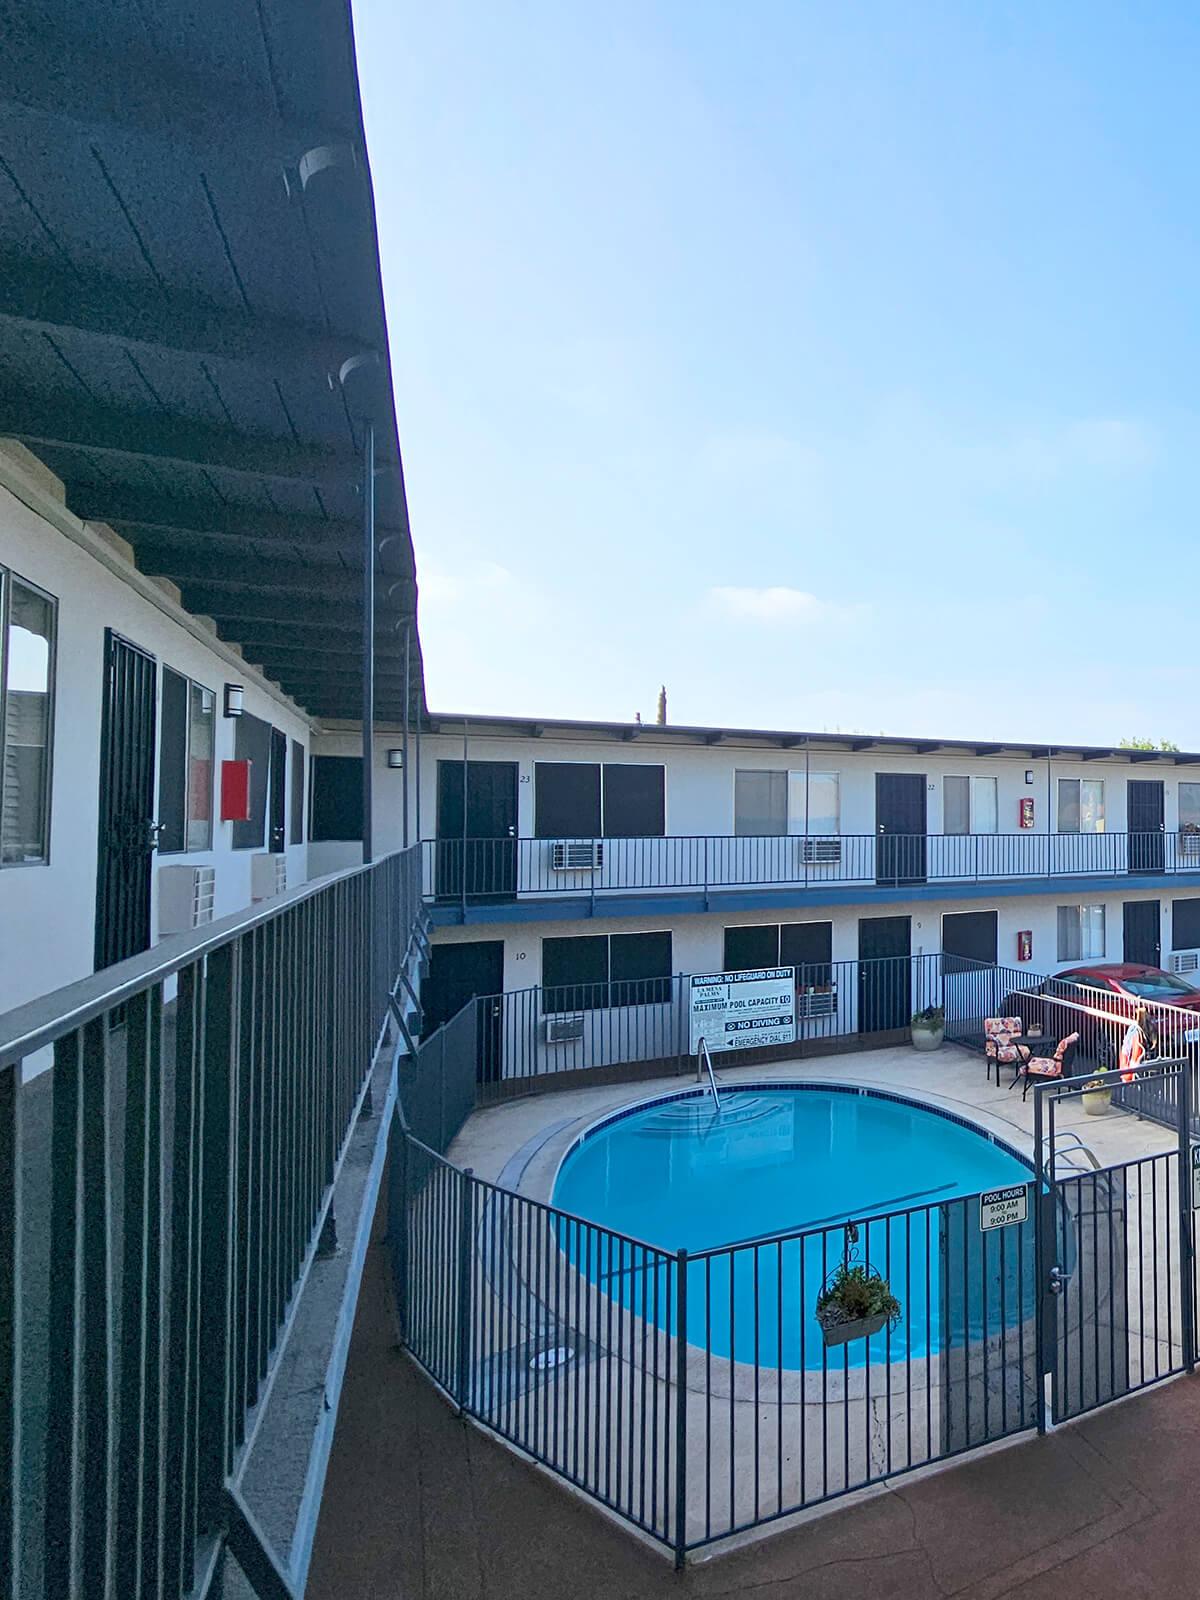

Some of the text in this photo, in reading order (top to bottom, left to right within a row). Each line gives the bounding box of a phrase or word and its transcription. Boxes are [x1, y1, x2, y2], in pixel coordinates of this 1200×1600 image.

[520, 776, 529, 784] 23
[516, 952, 526, 960] 10
[694, 968, 791, 985] WARNING: NO LIFEGUARD ON DUTY
[694, 1002, 728, 1012] MAXIMUM
[729, 1000, 746, 1009] POOL
[748, 997, 779, 1008] CAPACITY
[780, 995, 791, 1004] 10
[738, 1018, 780, 1030] NO DIVING
[736, 1036, 768, 1046] EMERGENCY
[770, 1035, 781, 1043] DIAL
[984, 1188, 1024, 1204] POOL HOURS
[990, 1200, 1018, 1213] 9:00 AM
[990, 1212, 1018, 1225] 9:00 PM
